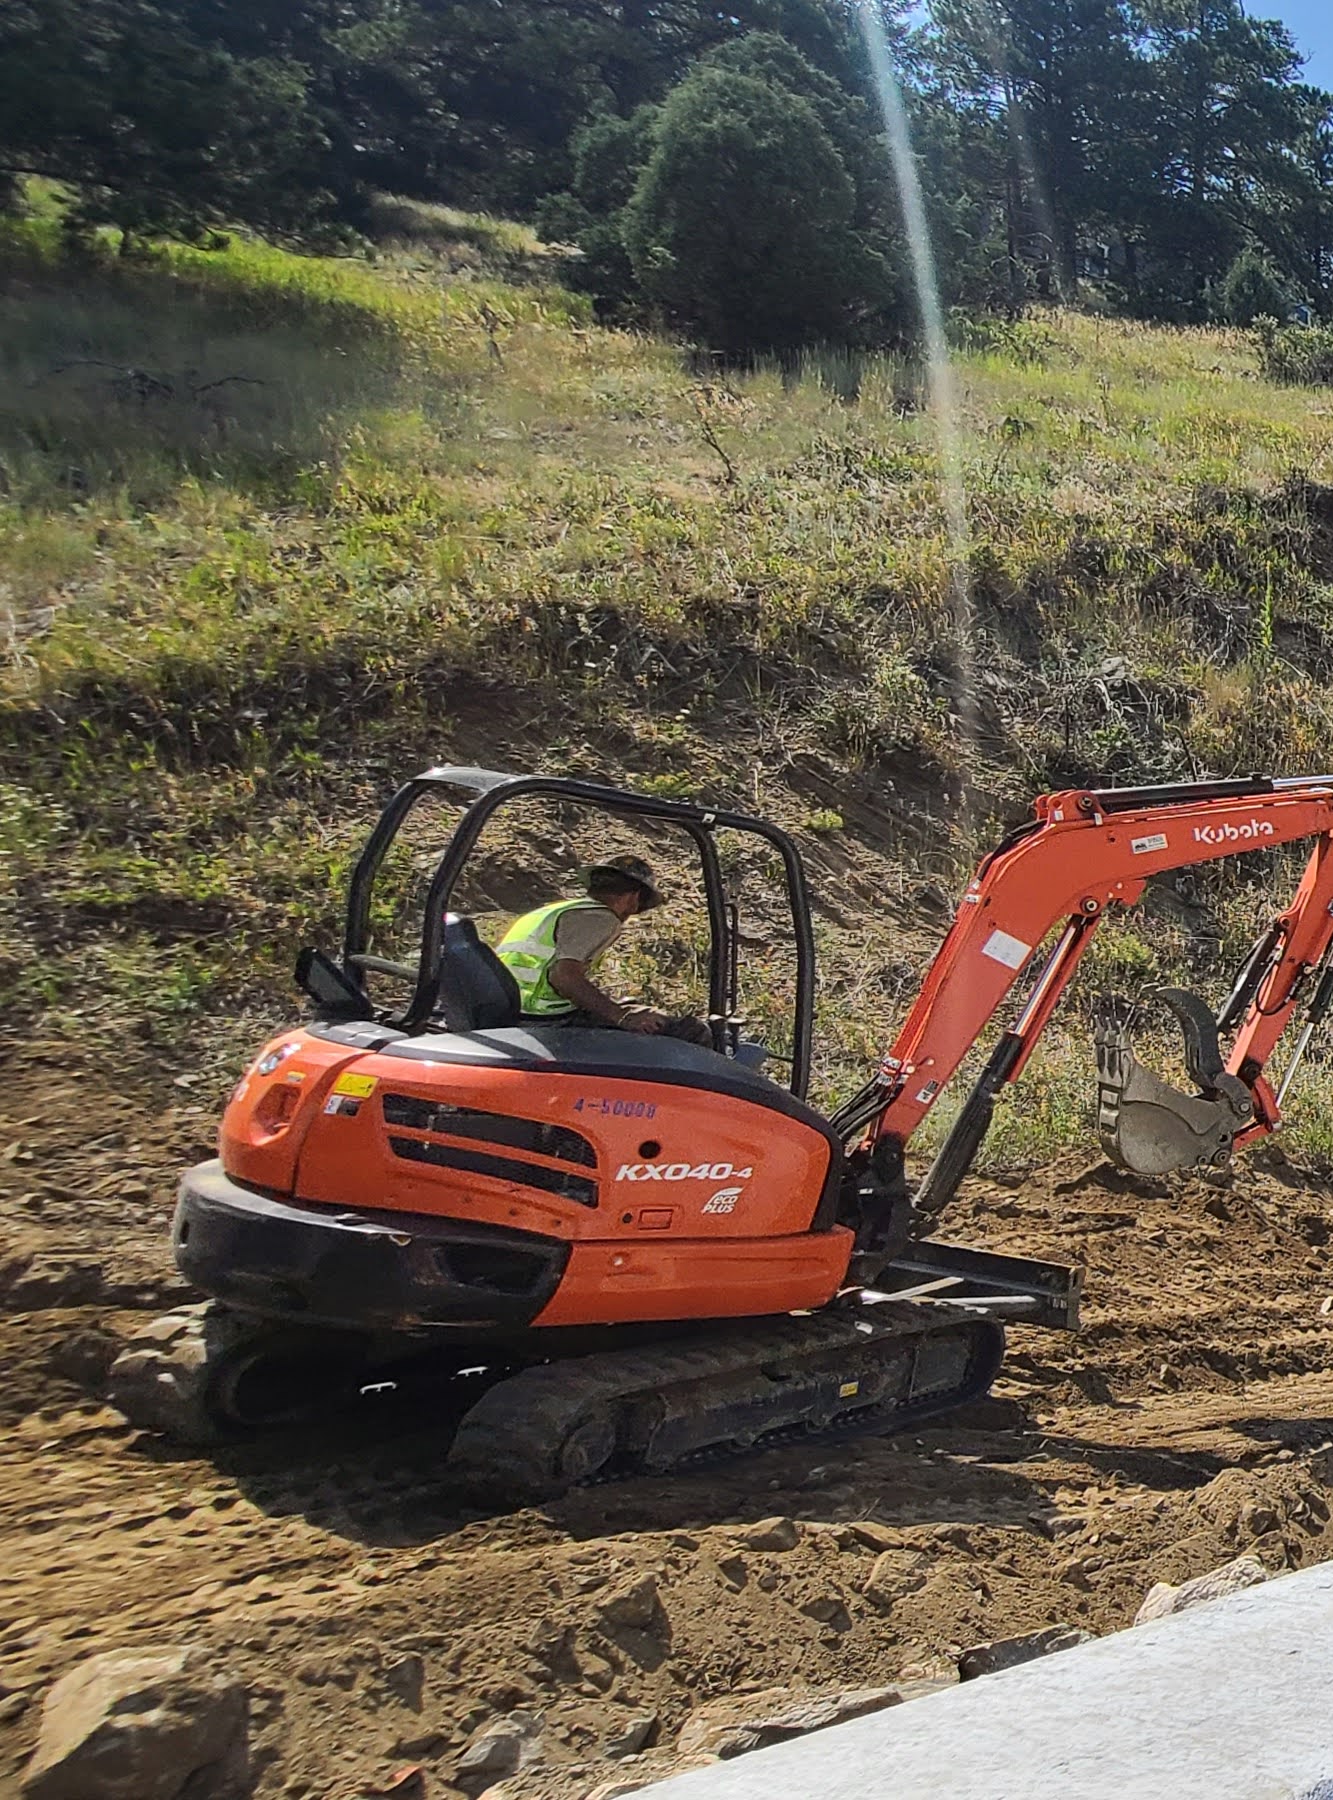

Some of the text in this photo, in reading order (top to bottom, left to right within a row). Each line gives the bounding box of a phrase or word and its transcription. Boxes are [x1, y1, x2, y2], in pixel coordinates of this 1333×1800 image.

[1193, 819, 1274, 844] Kubota
[615, 1163, 753, 1181] KX040-4
[714, 1194, 738, 1204] eco
[702, 1204, 736, 1214] PLUS
